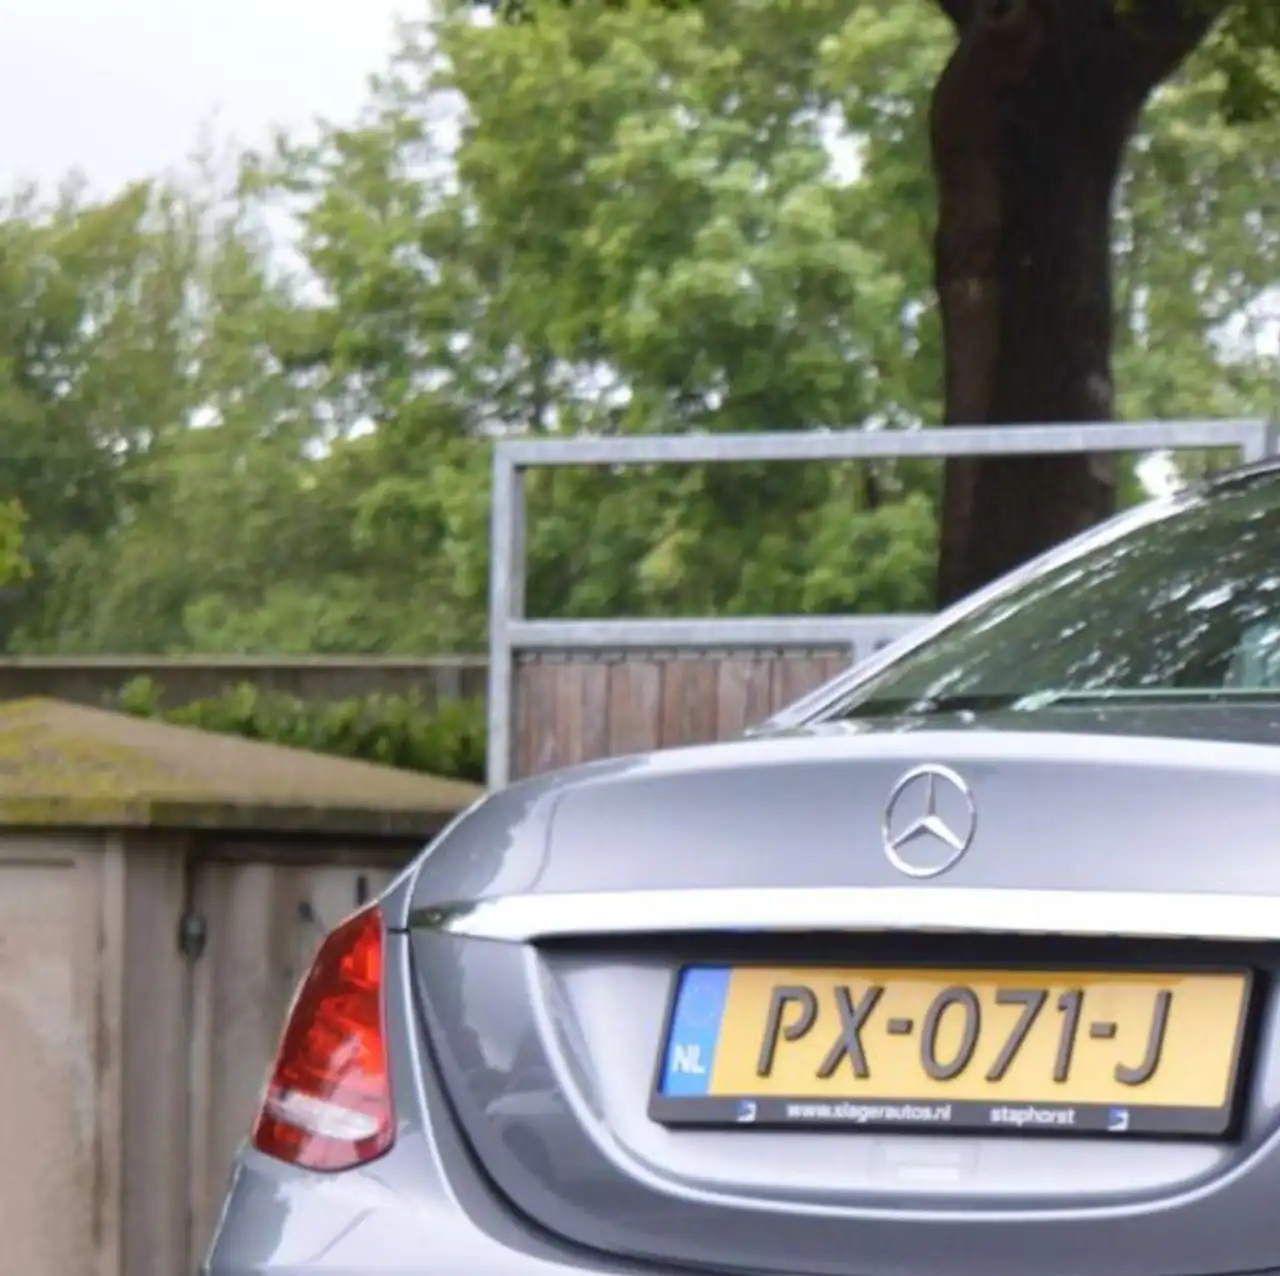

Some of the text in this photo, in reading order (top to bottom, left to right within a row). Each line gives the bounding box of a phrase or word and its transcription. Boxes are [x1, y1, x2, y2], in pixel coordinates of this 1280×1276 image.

[755, 984, 1173, 1087] PX-071-J
[671, 1043, 706, 1074] NL
[989, 1105, 1076, 1127] staphorst
